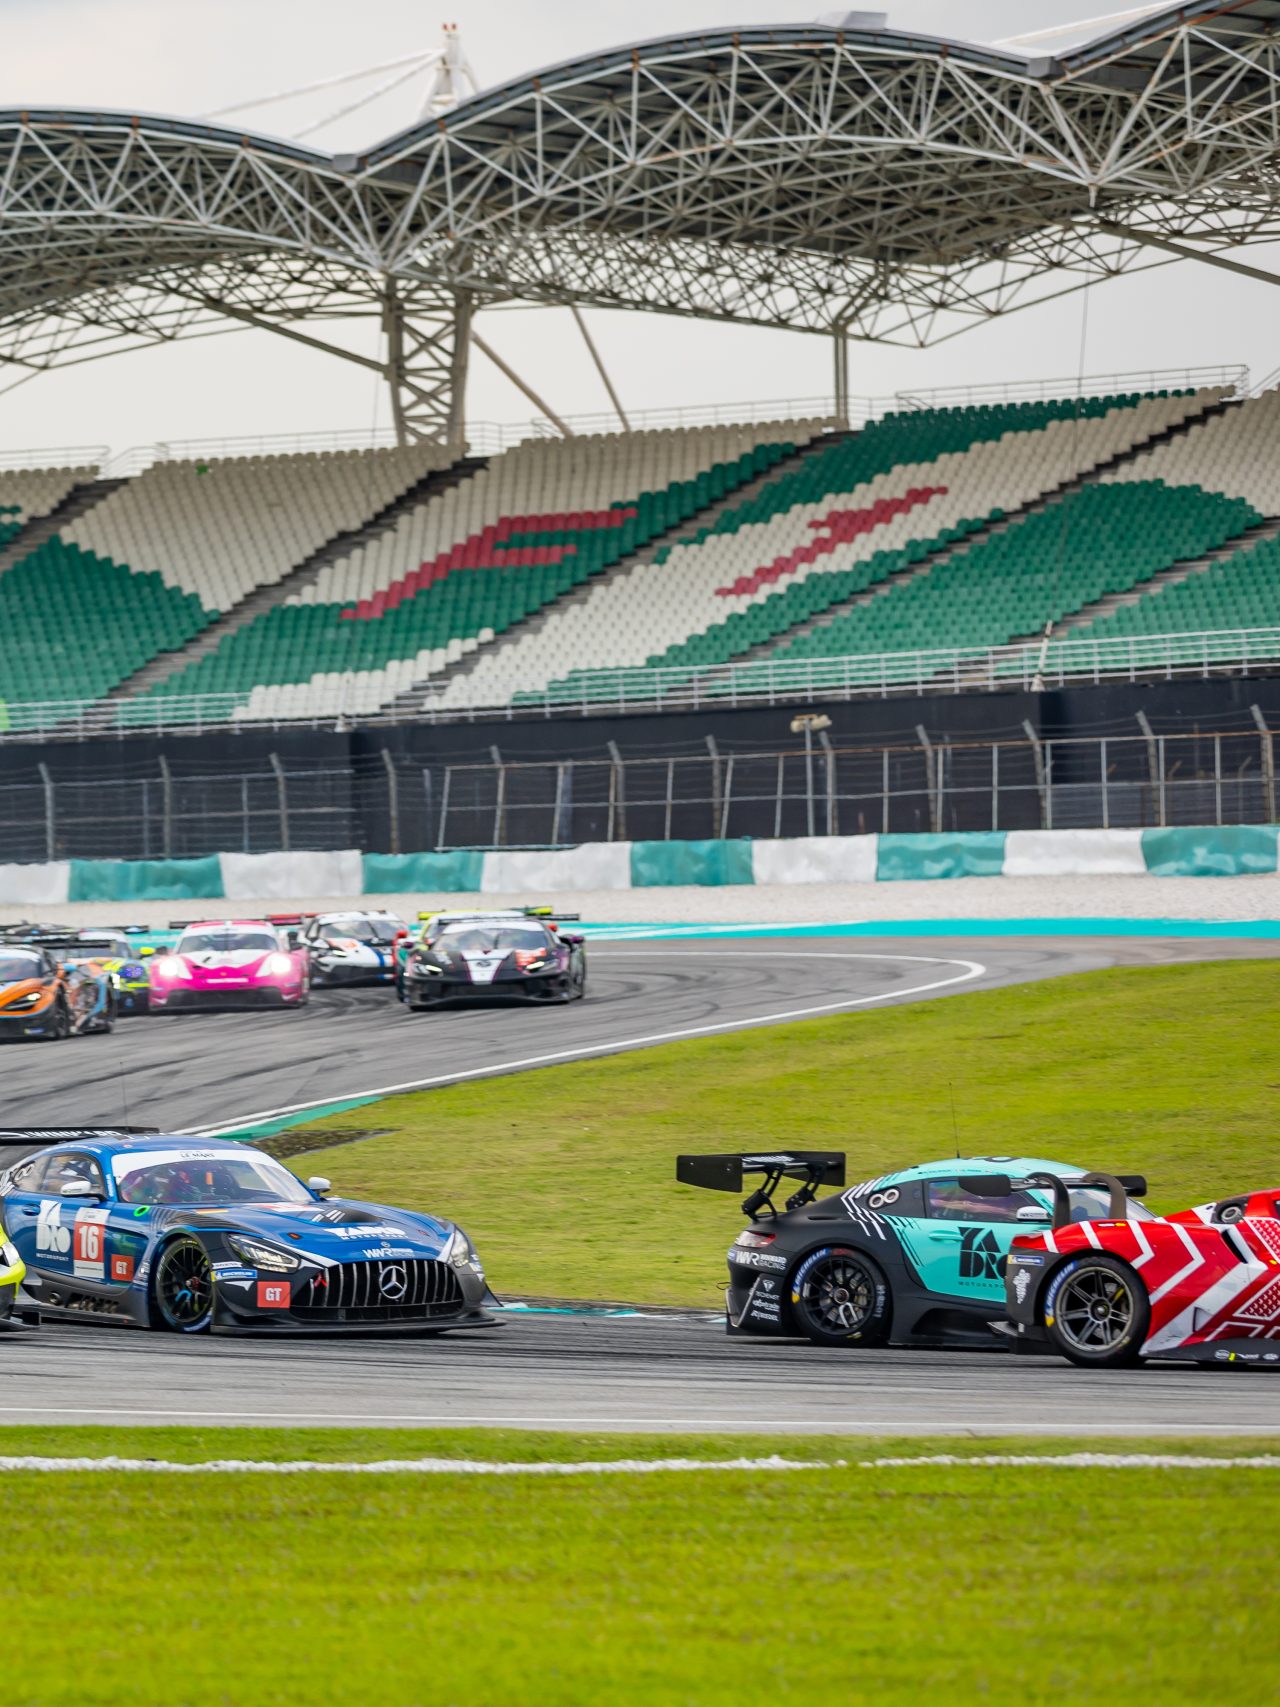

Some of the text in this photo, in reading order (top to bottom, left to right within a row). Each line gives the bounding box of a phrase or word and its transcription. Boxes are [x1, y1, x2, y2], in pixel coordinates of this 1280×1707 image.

[79, 1225, 100, 1260] 16
[116, 1261, 128, 1276] GT
[795, 1247, 828, 1286] MICHELIN
[265, 1287, 283, 1302] GT
[1046, 1262, 1075, 1307] MICHELIN
